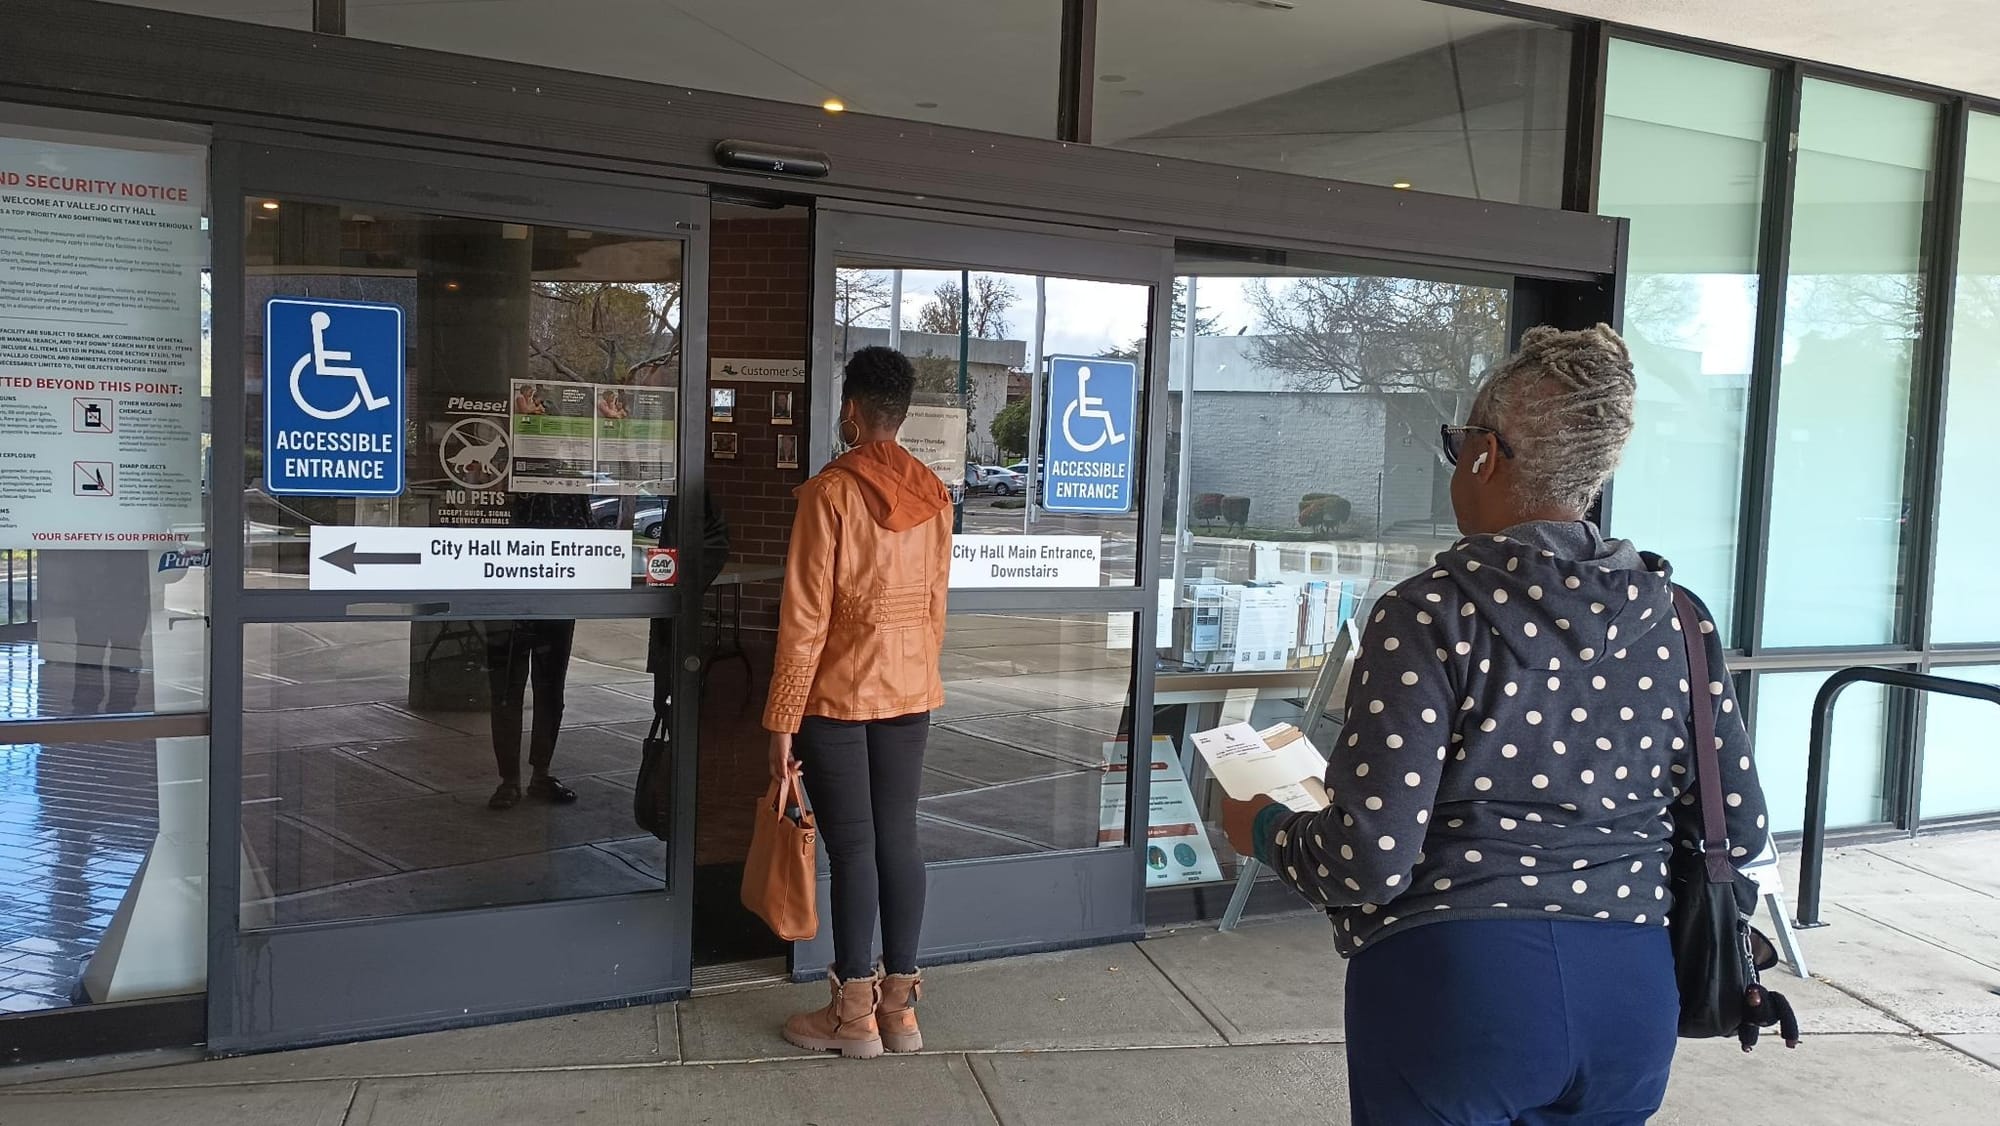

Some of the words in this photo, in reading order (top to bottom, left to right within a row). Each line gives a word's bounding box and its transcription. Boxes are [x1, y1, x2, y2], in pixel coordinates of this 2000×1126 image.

[26, 174, 116, 194] SECURITY
[122, 183, 188, 201] NOTICE
[2, 195, 51, 206] WELCOME
[66, 201, 108, 211] VALLEJO
[110, 205, 131, 214] CITY
[133, 207, 156, 216] HALL
[73, 215, 112, 223] SOMETHING
[741, 366, 789, 376] Customer
[36, 378, 95, 390] BEYOND
[99, 381, 131, 392] THIS
[135, 383, 183, 394] POINT:
[448, 397, 508, 412] Please!
[276, 431, 392, 452] ACCESSIBLE
[286, 458, 384, 479] ENTRANCE
[1052, 461, 1125, 478] ACCESSIBLE
[446, 490, 465, 504] NO
[472, 491, 504, 505] PETS
[1056, 482, 1119, 499] ENTRANCE
[32, 532, 62, 541] YOUR
[64, 533, 102, 541] SAFETY
[105, 533, 114, 541] IS
[118, 533, 140, 541] OUR
[142, 533, 189, 542] PRIORITY
[431, 540, 462, 559] City
[468, 540, 501, 556] Hall
[508, 541, 544, 556] Main
[552, 541, 625, 559] Entrance,
[953, 545, 976, 562] City
[980, 545, 1004, 558] Hall
[1008, 546, 1036, 558] Main
[1041, 546, 1096, 560] Entrance,
[484, 562, 576, 578] Downstairs
[991, 564, 1058, 577] Downstairs
